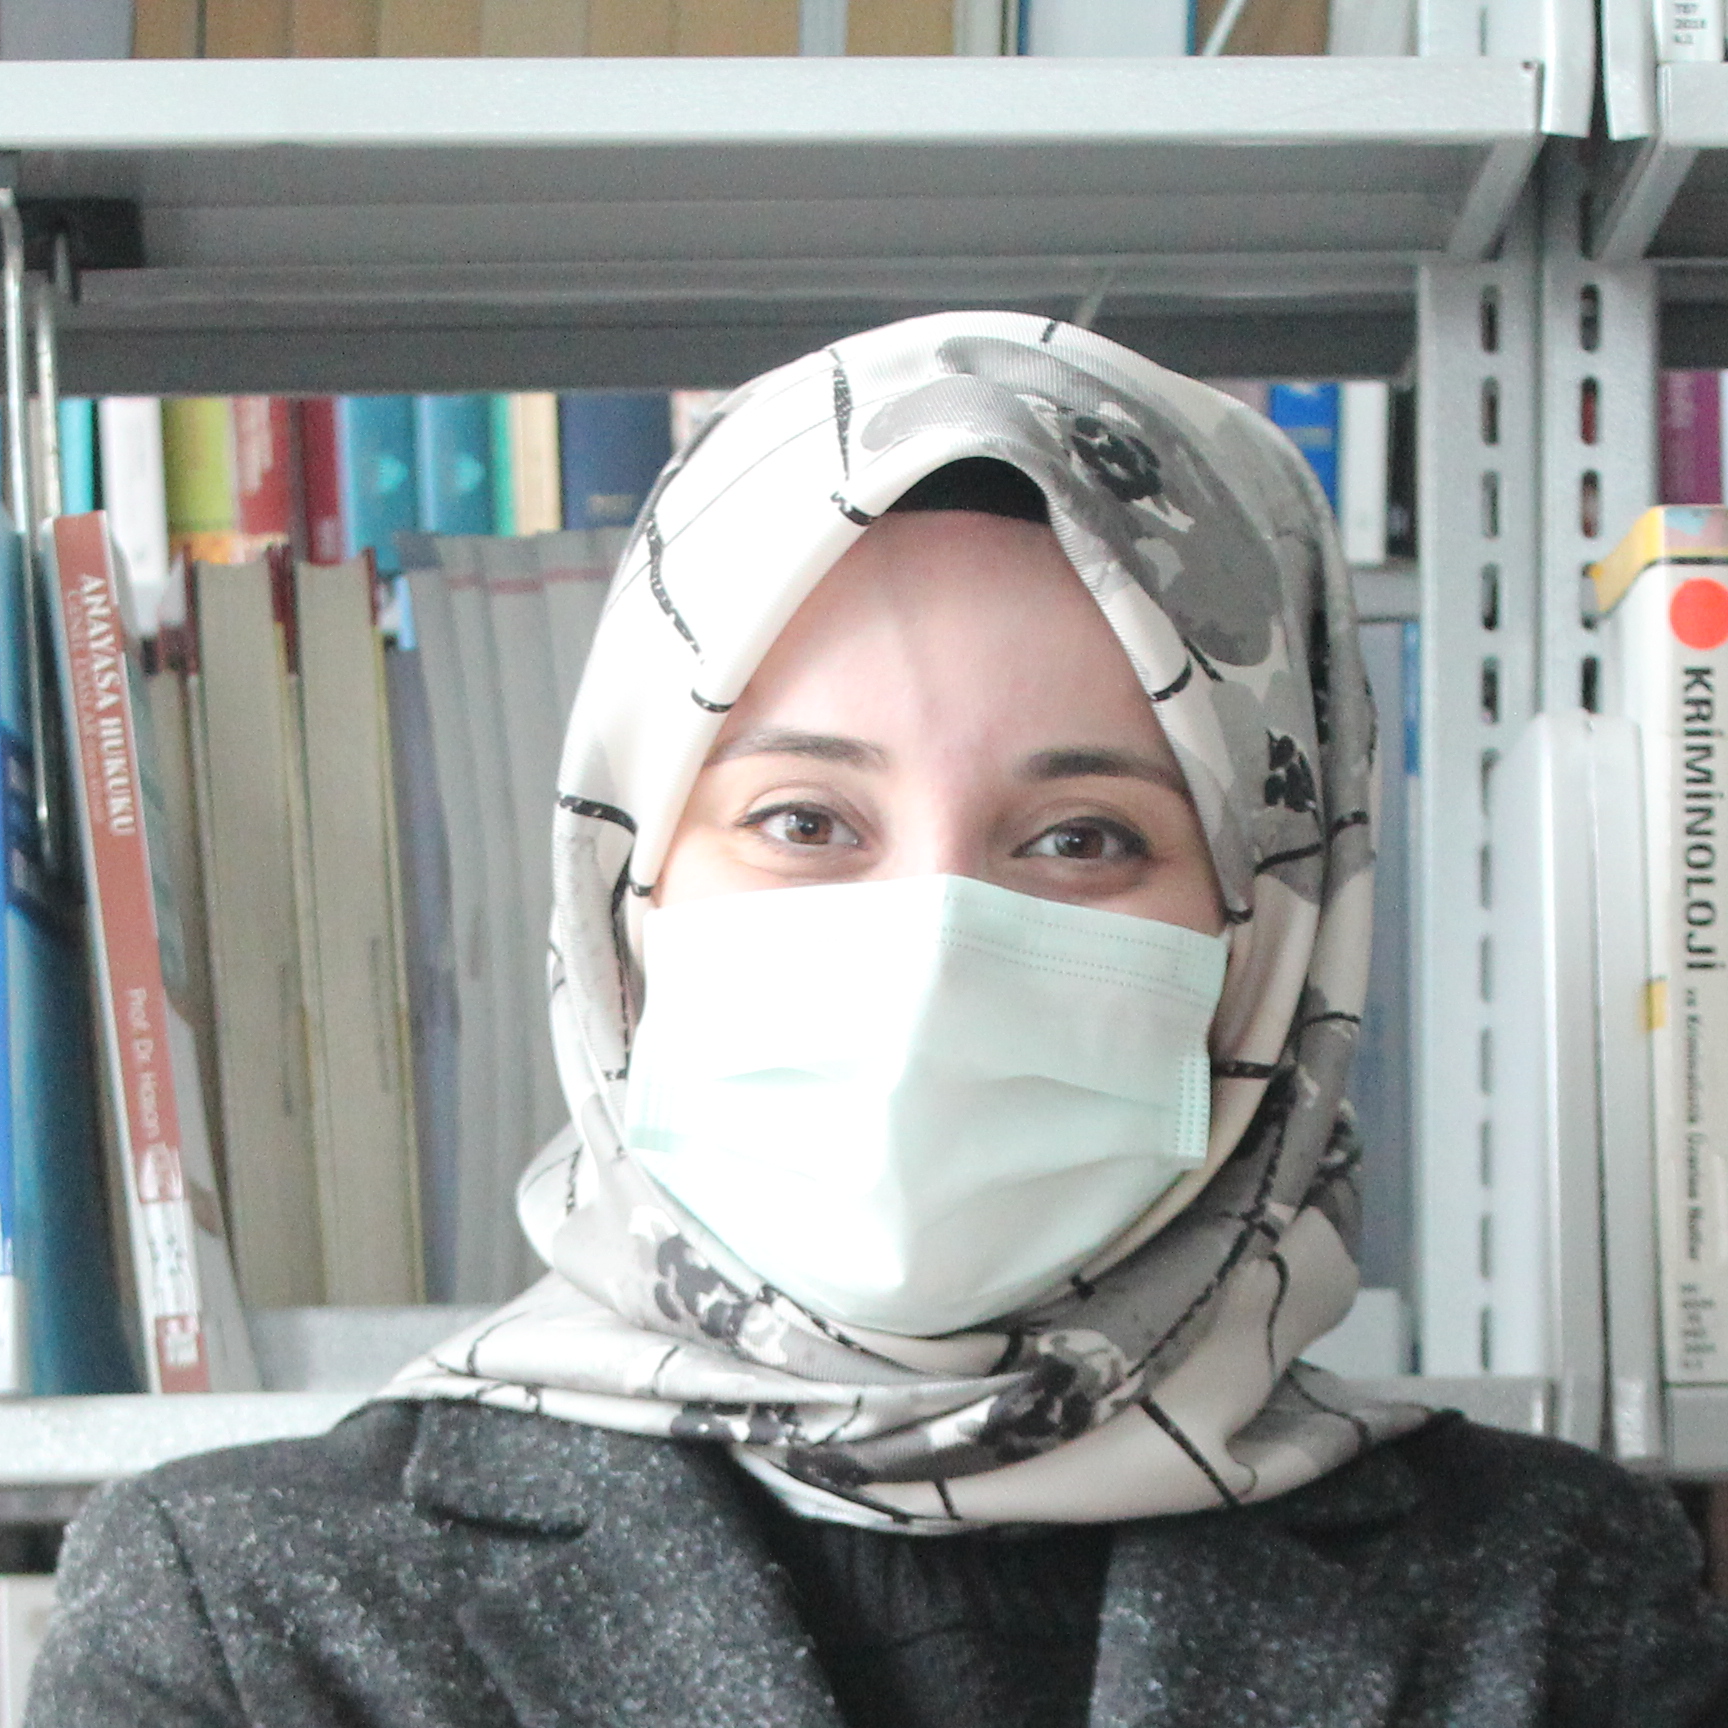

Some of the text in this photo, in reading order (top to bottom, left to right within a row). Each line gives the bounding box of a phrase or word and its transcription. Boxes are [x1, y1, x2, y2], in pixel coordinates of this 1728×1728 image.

[80, 575, 136, 836] ANAYASA HUKUKU
[1682, 665, 1725, 971] KRİMİNOLOJİ
